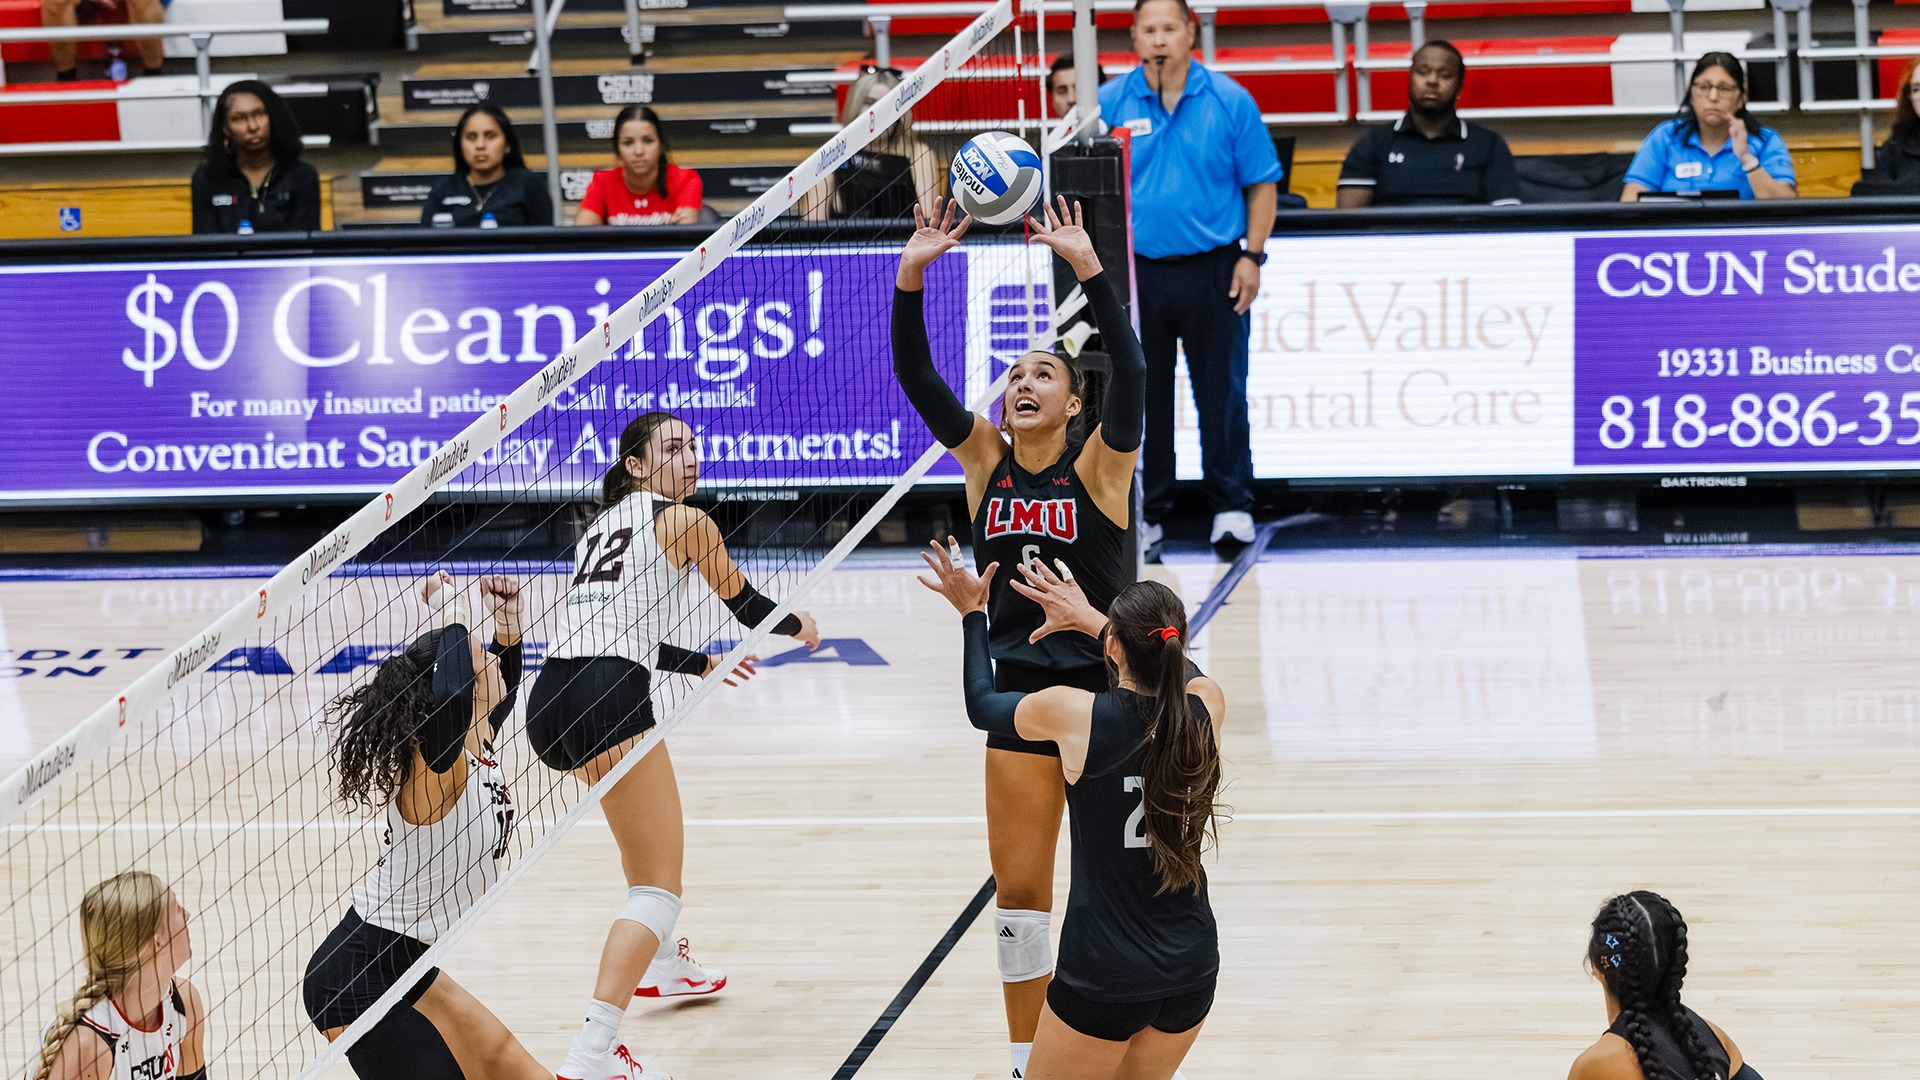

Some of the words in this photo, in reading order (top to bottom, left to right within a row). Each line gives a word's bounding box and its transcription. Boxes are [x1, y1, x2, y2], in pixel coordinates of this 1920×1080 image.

[954, 157, 985, 196] molten
[962, 146, 996, 181] NCAA
[729, 205, 765, 247] Matadors
[1597, 249, 1768, 297] CSUN
[1783, 246, 1920, 294] Stude
[638, 278, 676, 322] Matadors
[1253, 276, 1553, 366] id-Valley
[121, 273, 240, 388] $0
[272, 271, 827, 383] Cleanings!
[537, 355, 577, 402] Matadors
[1656, 348, 1739, 378] 19331
[1749, 346, 1878, 376] Business
[190, 392, 238, 418] For
[243, 395, 318, 422] many
[324, 387, 423, 416] insured
[551, 384, 611, 411] Call
[614, 384, 655, 409] for
[657, 380, 757, 410] details!
[1397, 368, 1543, 428] Care
[1599, 391, 1920, 450] 818-886-35
[87, 431, 345, 473] Convenient
[356, 425, 556, 475] Satuday
[565, 420, 902, 465] Aintments!
[424, 439, 469, 490] Matadors
[1660, 476, 1747, 488] DAKTRONICS
[984, 497, 1079, 545] LMU
[302, 531, 351, 586] Matadors
[571, 527, 633, 587] 12
[1021, 544, 1045, 588] 6
[167, 631, 221, 690] Matadors
[18, 742, 76, 805] Matadors
[1123, 776, 1150, 849] 2
